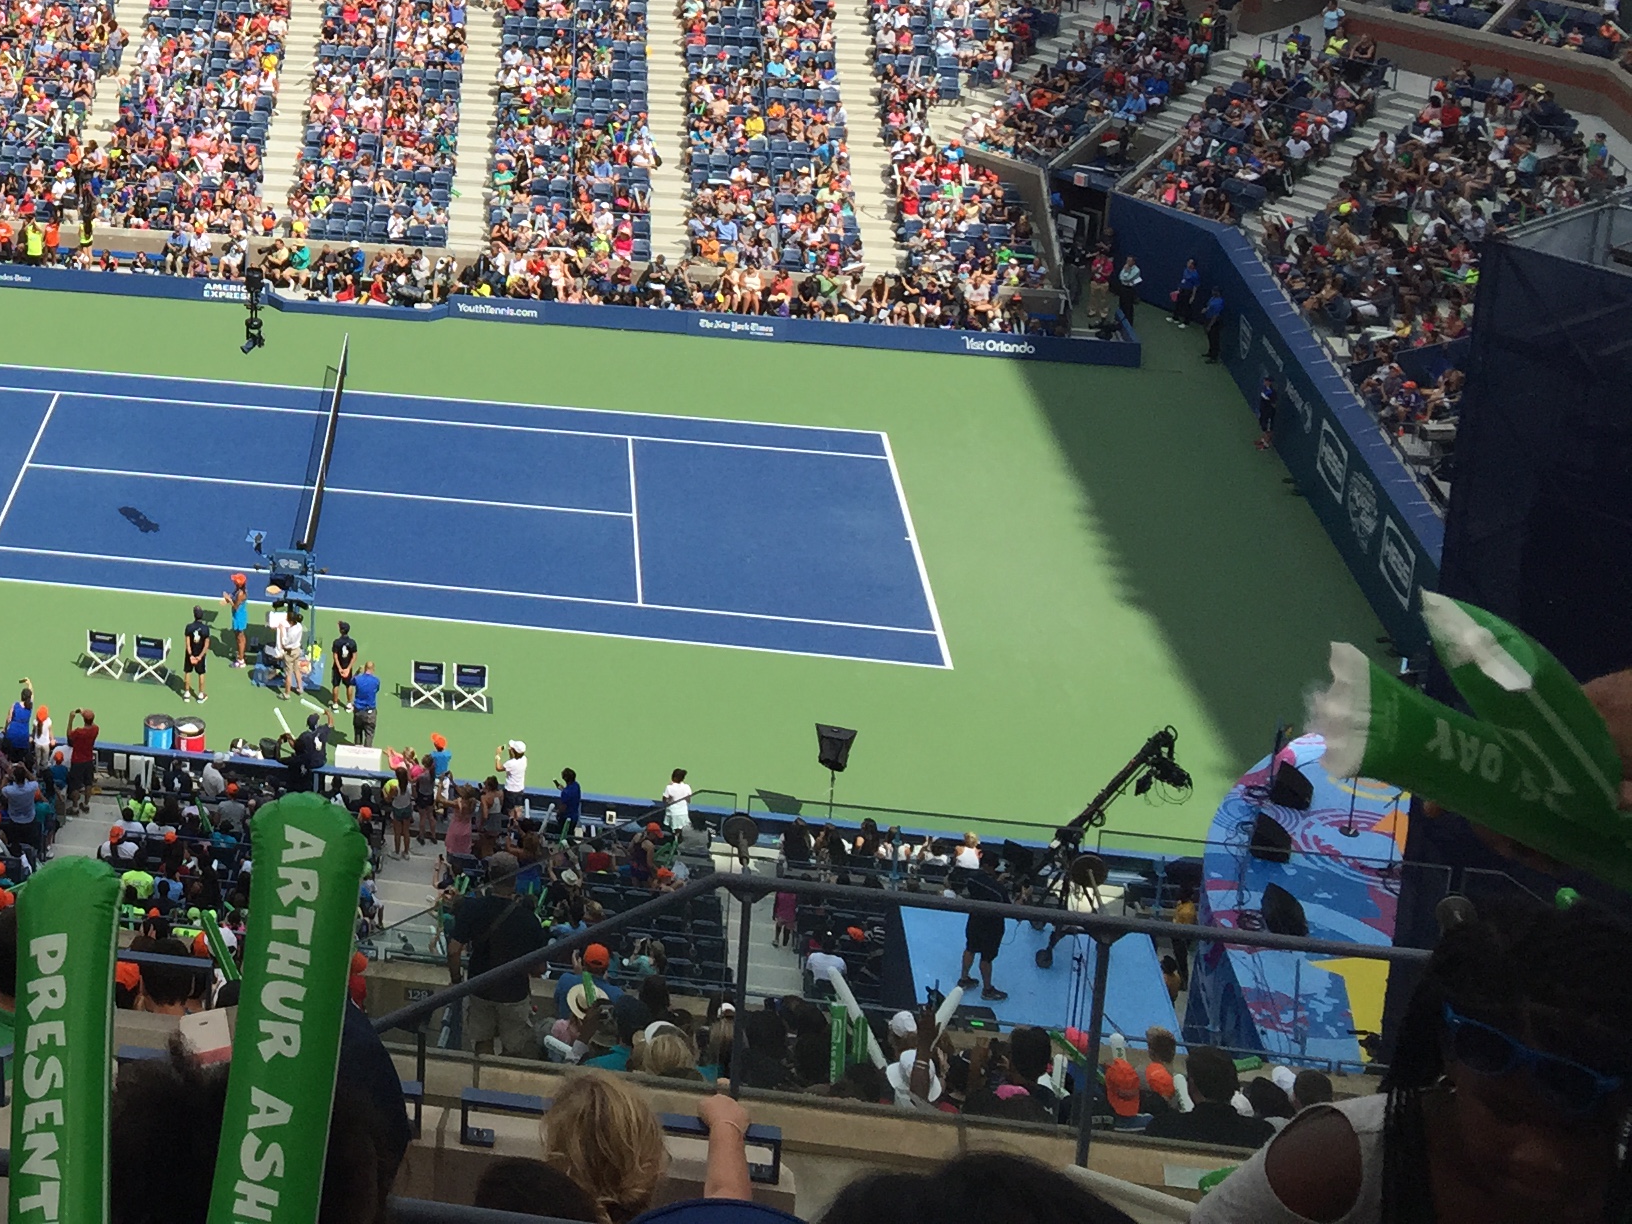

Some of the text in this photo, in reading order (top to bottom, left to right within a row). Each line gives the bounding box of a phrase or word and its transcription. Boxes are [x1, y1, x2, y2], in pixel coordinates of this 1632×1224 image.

[457, 302, 538, 319] YouthTennis.com
[960, 335, 1036, 354] Visit Orlando
[18, 932, 68, 1224] PRESENT
[231, 823, 327, 1224] ARTHUR ASH
